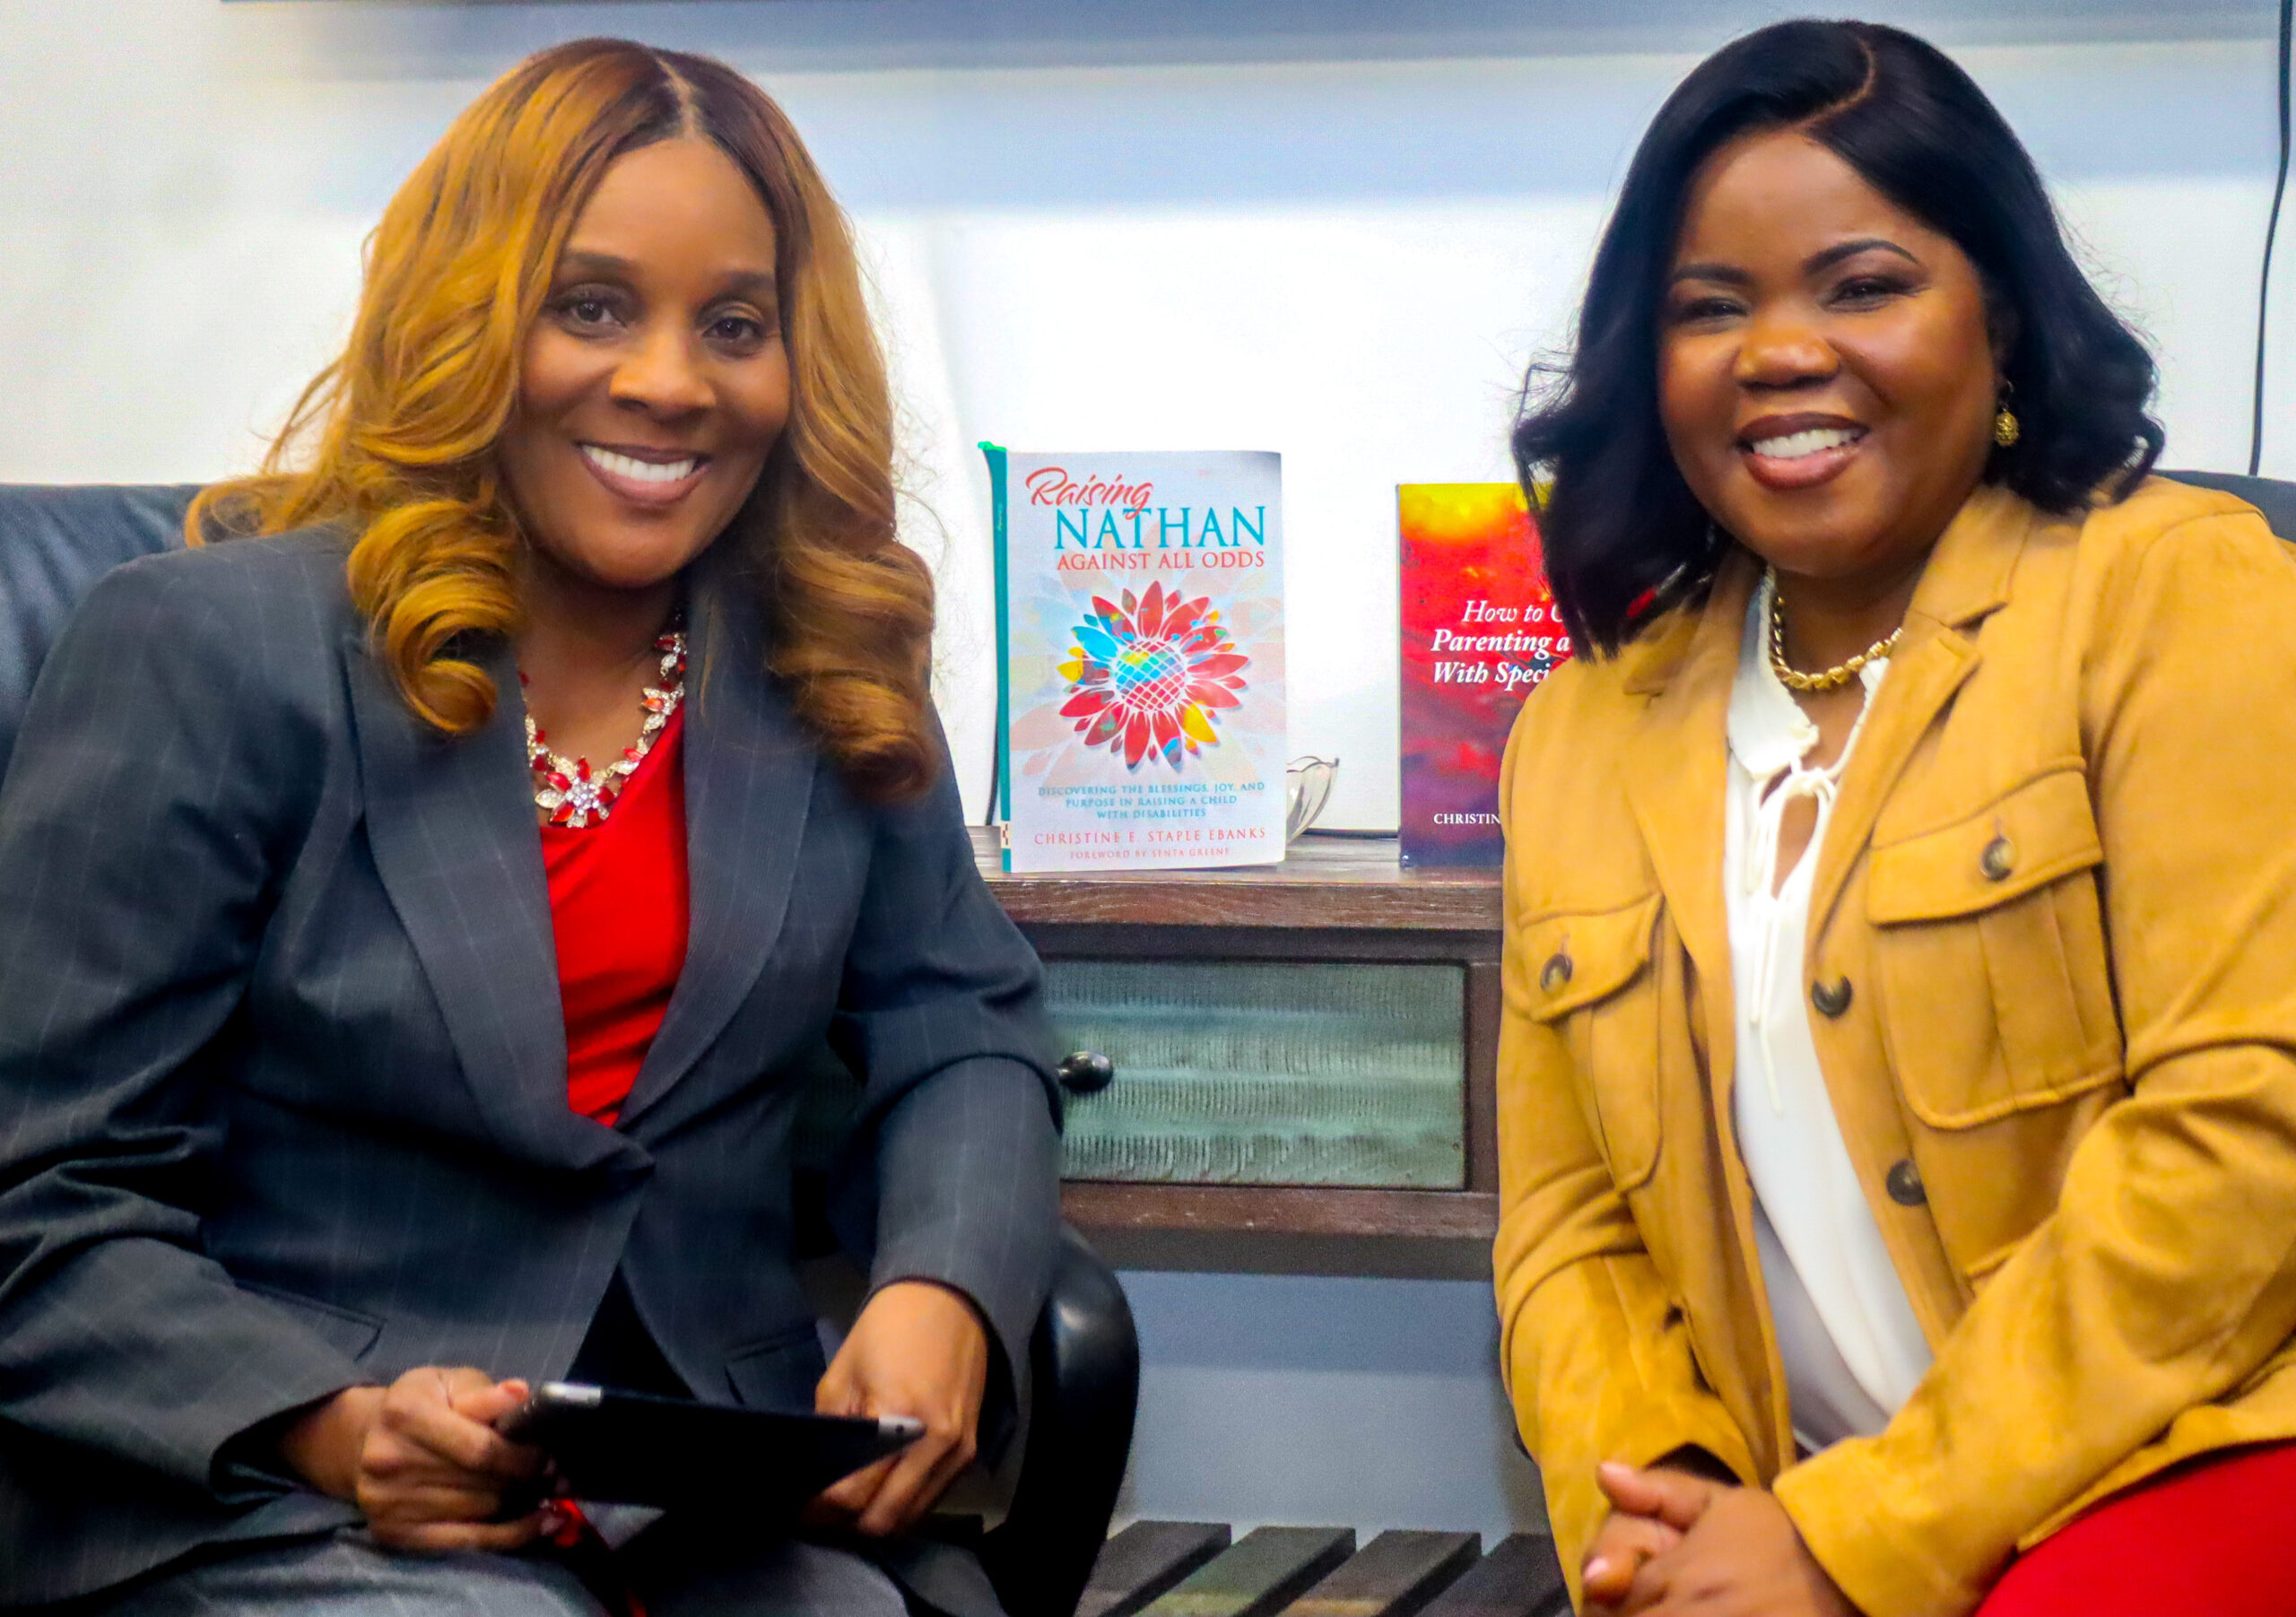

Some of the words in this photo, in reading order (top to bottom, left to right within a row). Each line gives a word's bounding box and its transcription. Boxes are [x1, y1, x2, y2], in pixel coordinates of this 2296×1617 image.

[1025, 466, 1153, 520] Raising
[1054, 505, 1265, 550] NATHAN
[1057, 552, 1151, 570] AGAINST
[1158, 552, 1195, 569] ALL
[1202, 551, 1265, 568] ODDS
[1461, 600, 1518, 622] How
[1523, 604, 1543, 622] to
[1430, 628, 1552, 660] Parenting
[1433, 661, 1489, 683] With
[1038, 786, 1117, 796] DISCOVERING
[1121, 785, 1144, 794] THE
[1240, 781, 1265, 791] AND
[1065, 797, 1116, 808] PURPOSE
[1119, 797, 1132, 806] IN
[1138, 796, 1187, 806] RAISING
[1202, 795, 1238, 804] CHILD
[1097, 810, 1127, 819] WITH
[1133, 808, 1206, 819] DISABILITIES
[1034, 831, 1120, 845] CHRISTINE
[1147, 830, 1201, 842] STAPLE
[1209, 827, 1266, 841] EBANKS
[1135, 849, 1146, 858] BY
